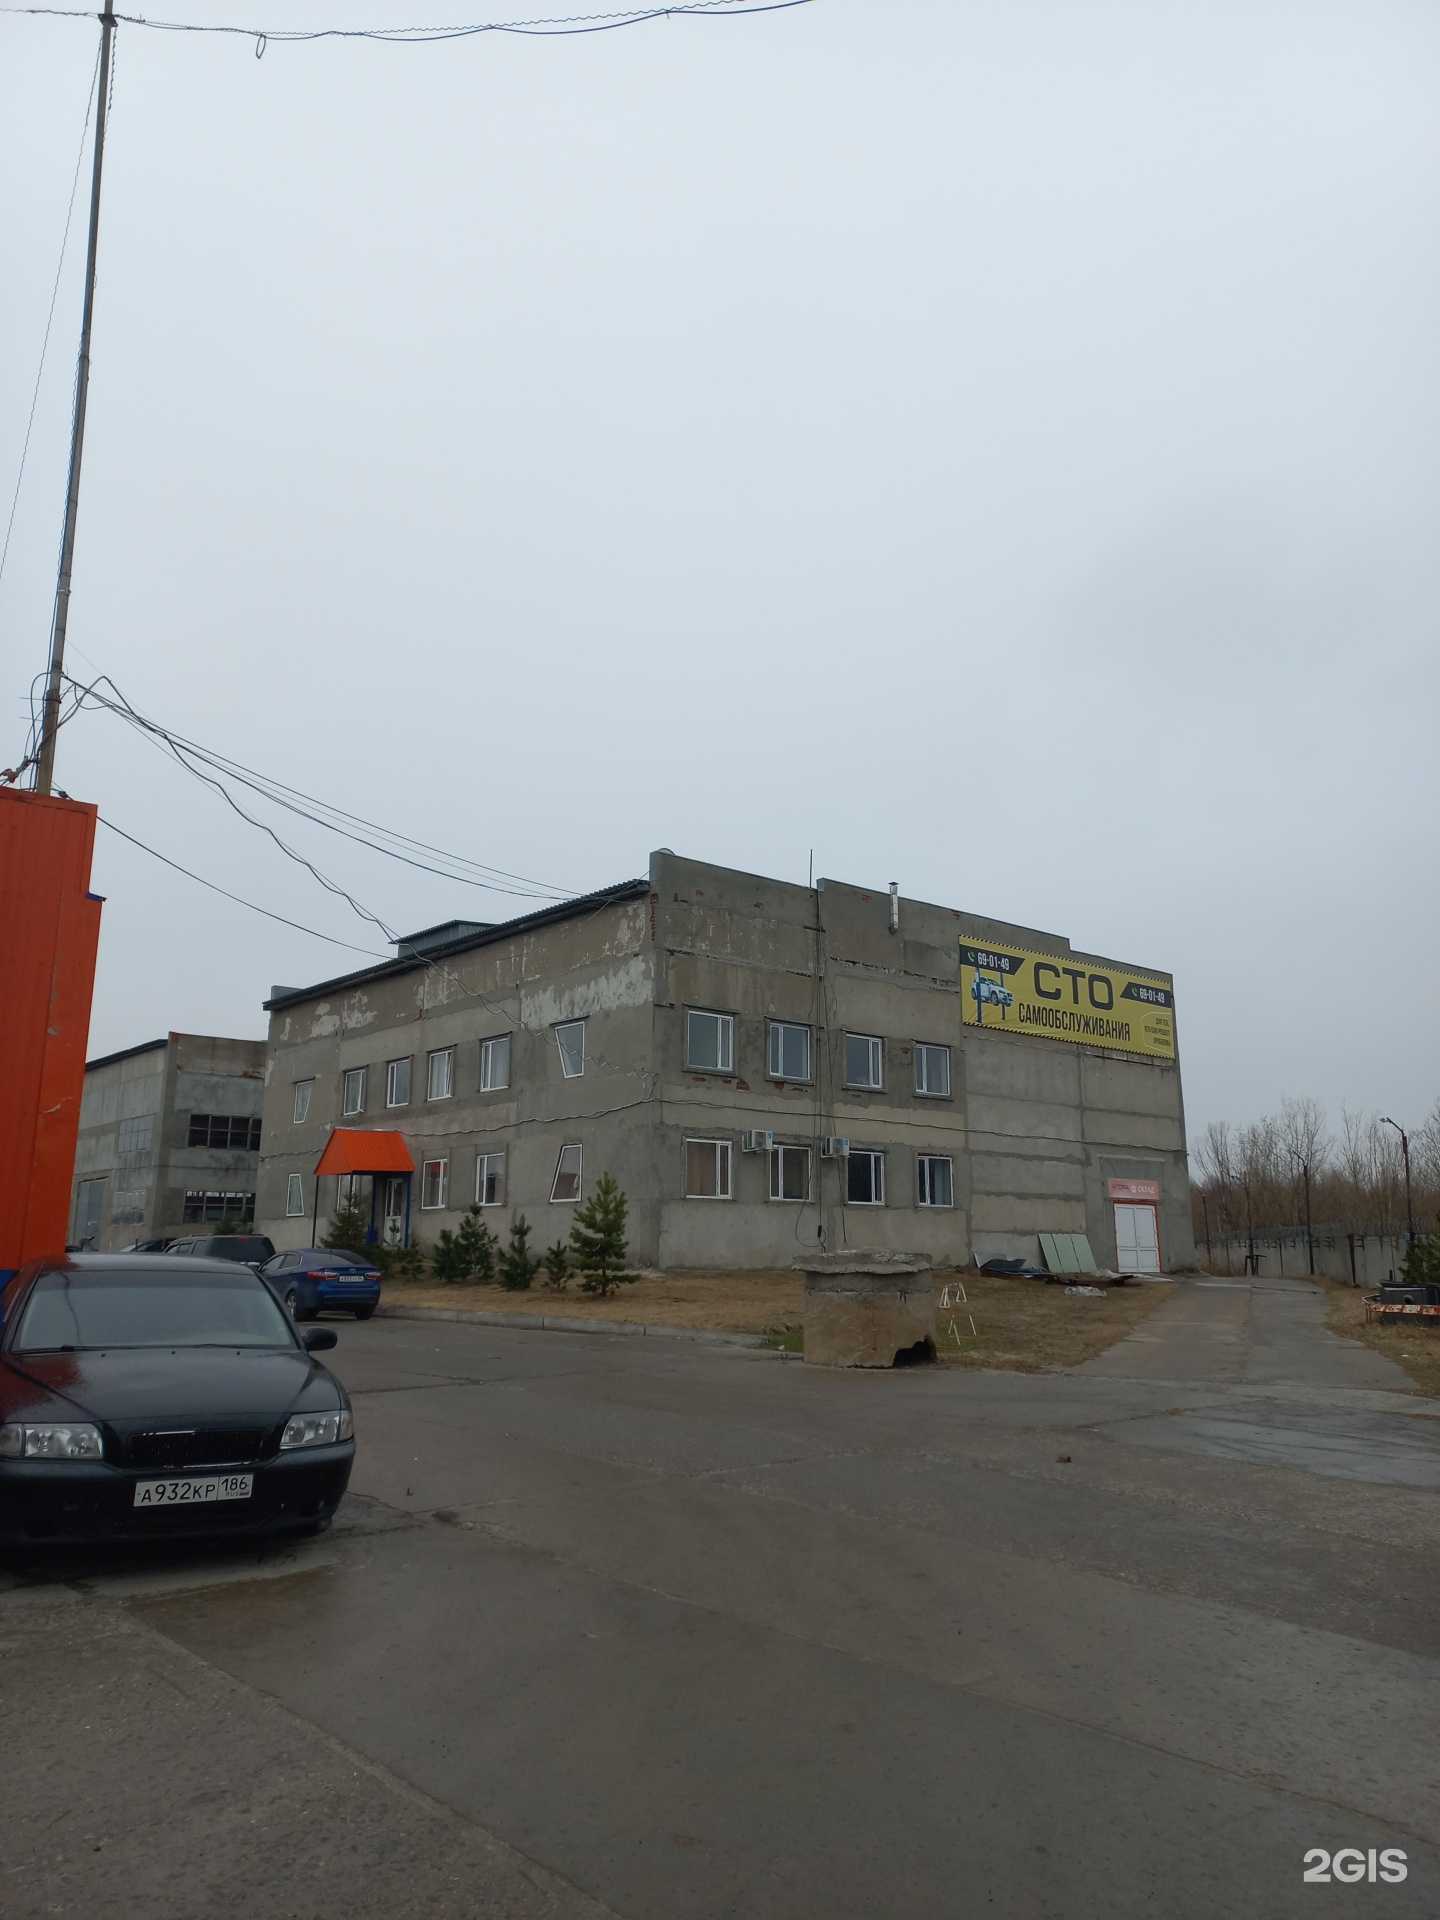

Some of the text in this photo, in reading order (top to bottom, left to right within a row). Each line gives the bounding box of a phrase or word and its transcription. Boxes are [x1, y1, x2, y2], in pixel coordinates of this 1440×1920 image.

[977, 952, 1010, 971] 69-01-49
[1033, 961, 1114, 1011] СТО
[1139, 986, 1165, 1004] 69-01-49
[1018, 1002, 1131, 1042] САМООБСЛУЖИВАНИЯ
